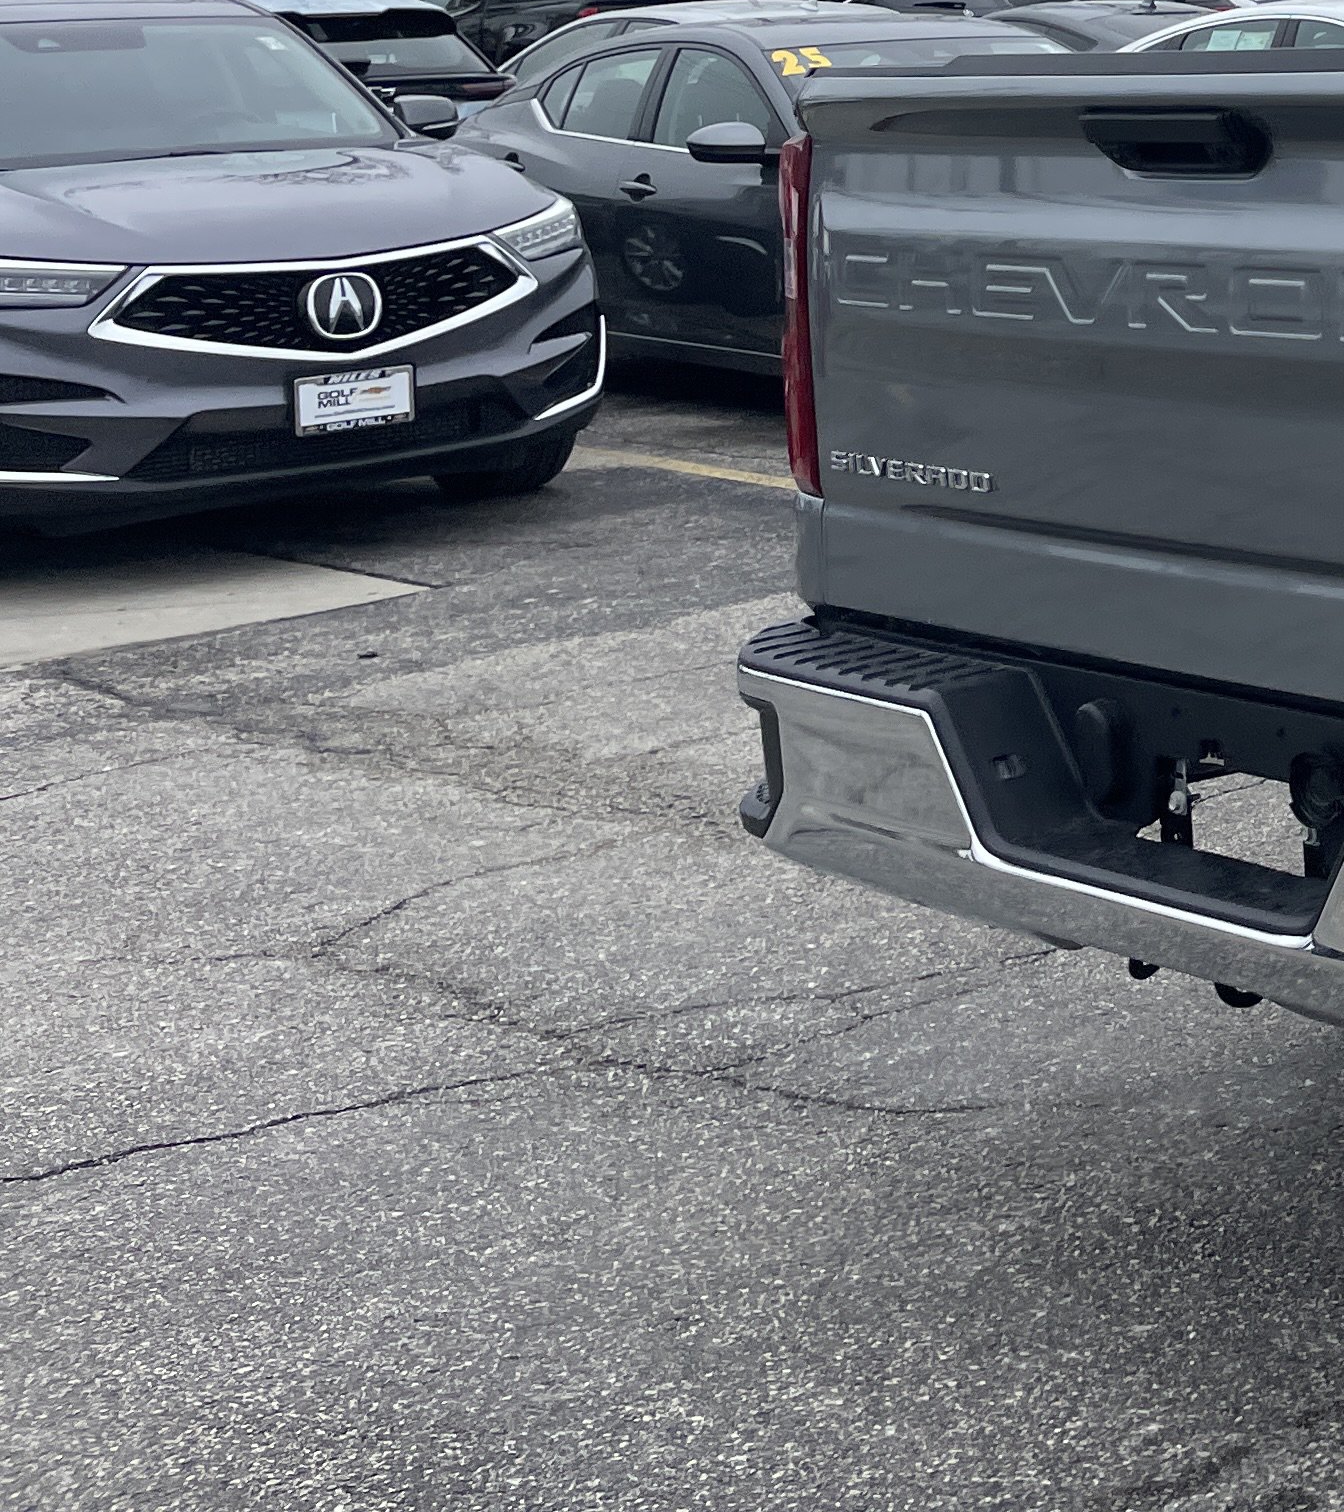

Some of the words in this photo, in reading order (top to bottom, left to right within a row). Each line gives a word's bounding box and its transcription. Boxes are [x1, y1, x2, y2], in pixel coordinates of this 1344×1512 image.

[771, 47, 833, 77] 25
[317, 387, 358, 400] GOLF
[317, 394, 351, 409] MILL
[326, 418, 356, 431] GOLF
[358, 415, 386, 427] MILL
[830, 450, 996, 493] SILVERADO
